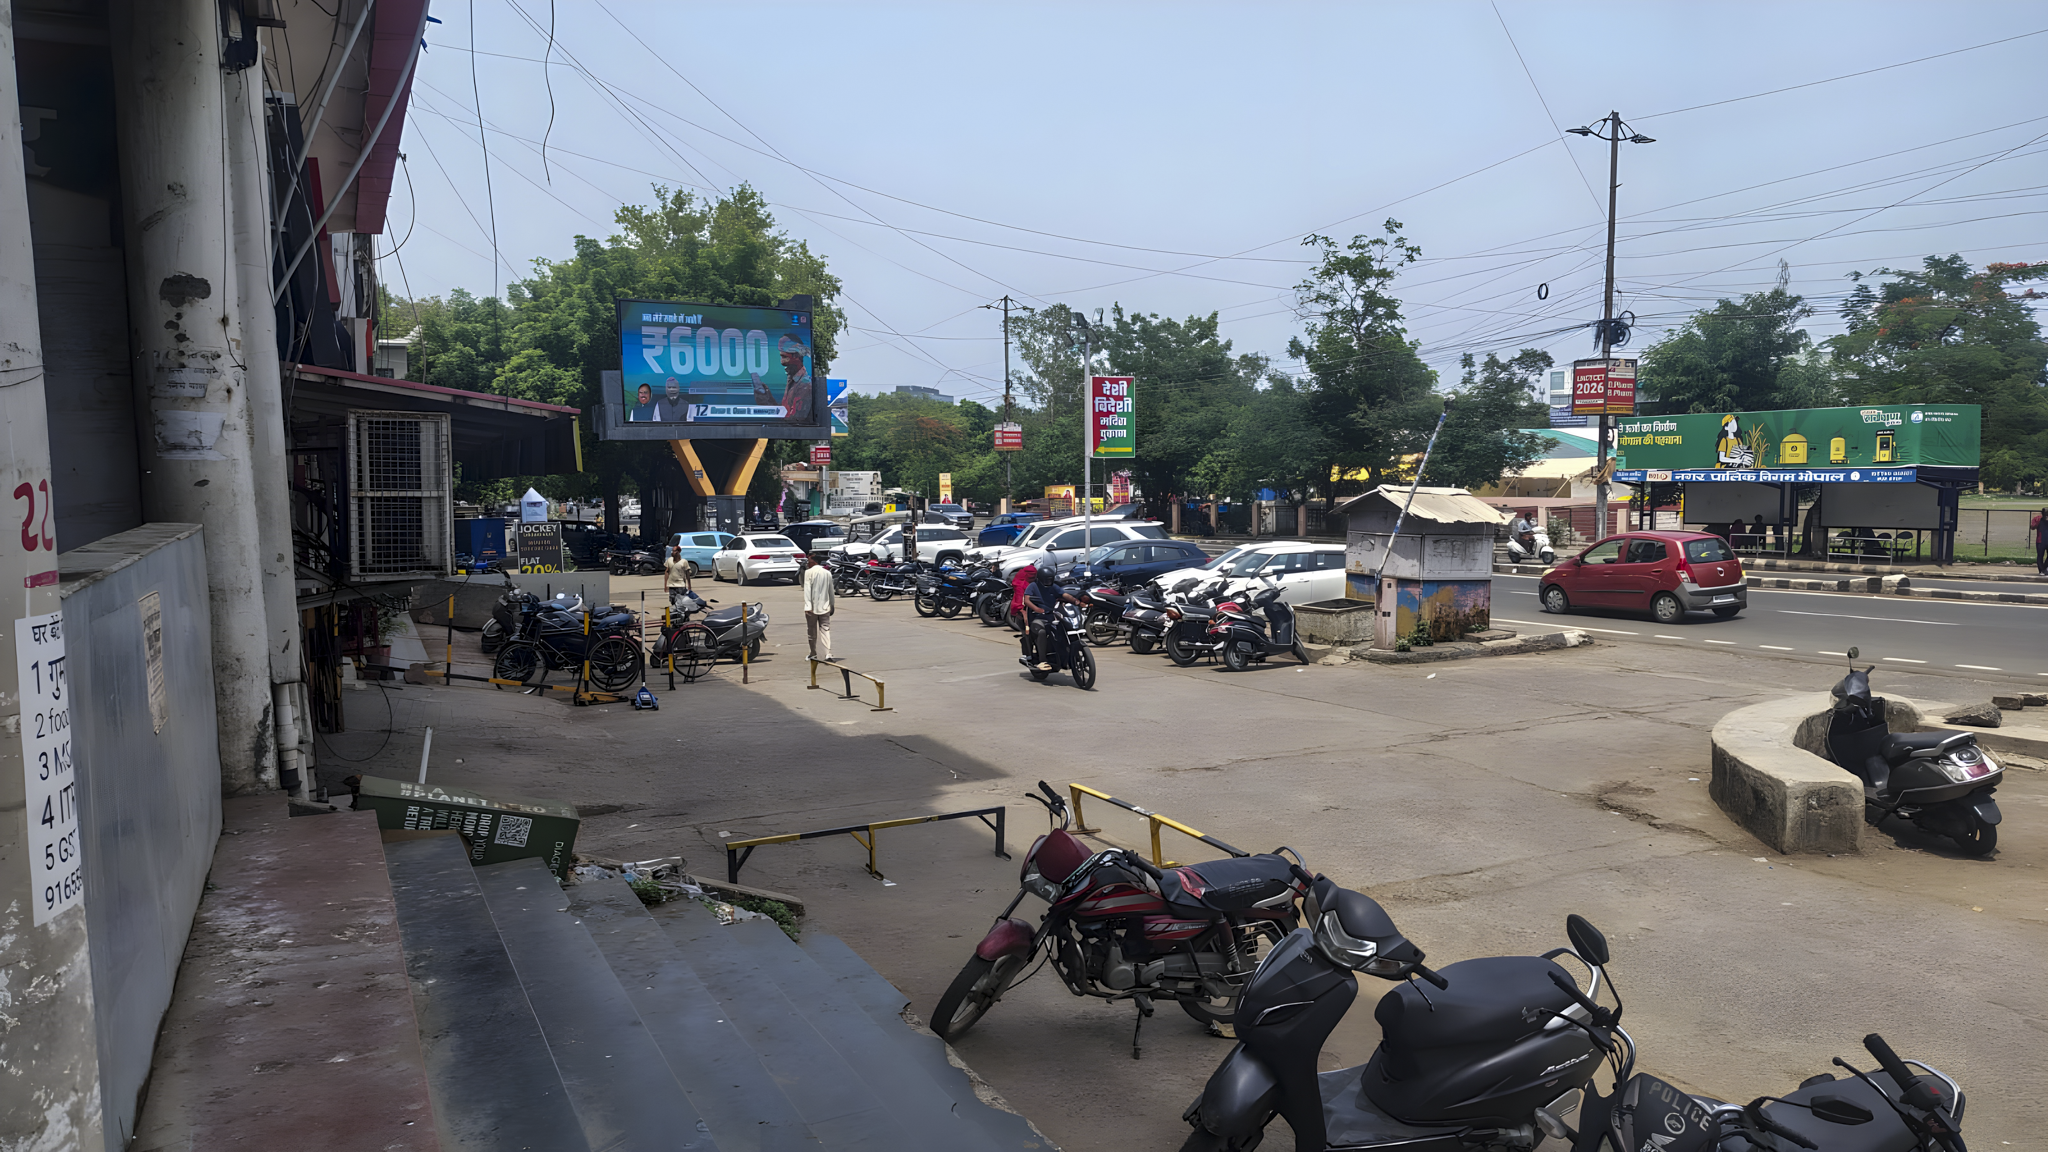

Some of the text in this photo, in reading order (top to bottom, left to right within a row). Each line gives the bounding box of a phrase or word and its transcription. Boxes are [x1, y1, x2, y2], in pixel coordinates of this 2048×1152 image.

[641, 326, 769, 376] ₹6000
[1102, 381, 1127, 395] देशी
[1577, 383, 1604, 394] 2026
[695, 404, 708, 416] 12
[1094, 396, 1132, 413] विदेशी
[1675, 473, 1705, 481] नगर
[1760, 470, 1796, 482] निगम
[1798, 470, 1846, 482] भोपाल
[520, 524, 557, 533] JOCKEY
[521, 557, 540, 565] FLAT
[32, 624, 48, 646] घर
[31, 660, 41, 694] 1
[34, 712, 46, 739] 2
[38, 751, 50, 781] 3
[41, 794, 55, 830] 4
[477, 813, 493, 839] DROP
[45, 843, 55, 871] 5
[1648, 1081, 1712, 1132] POLICE
